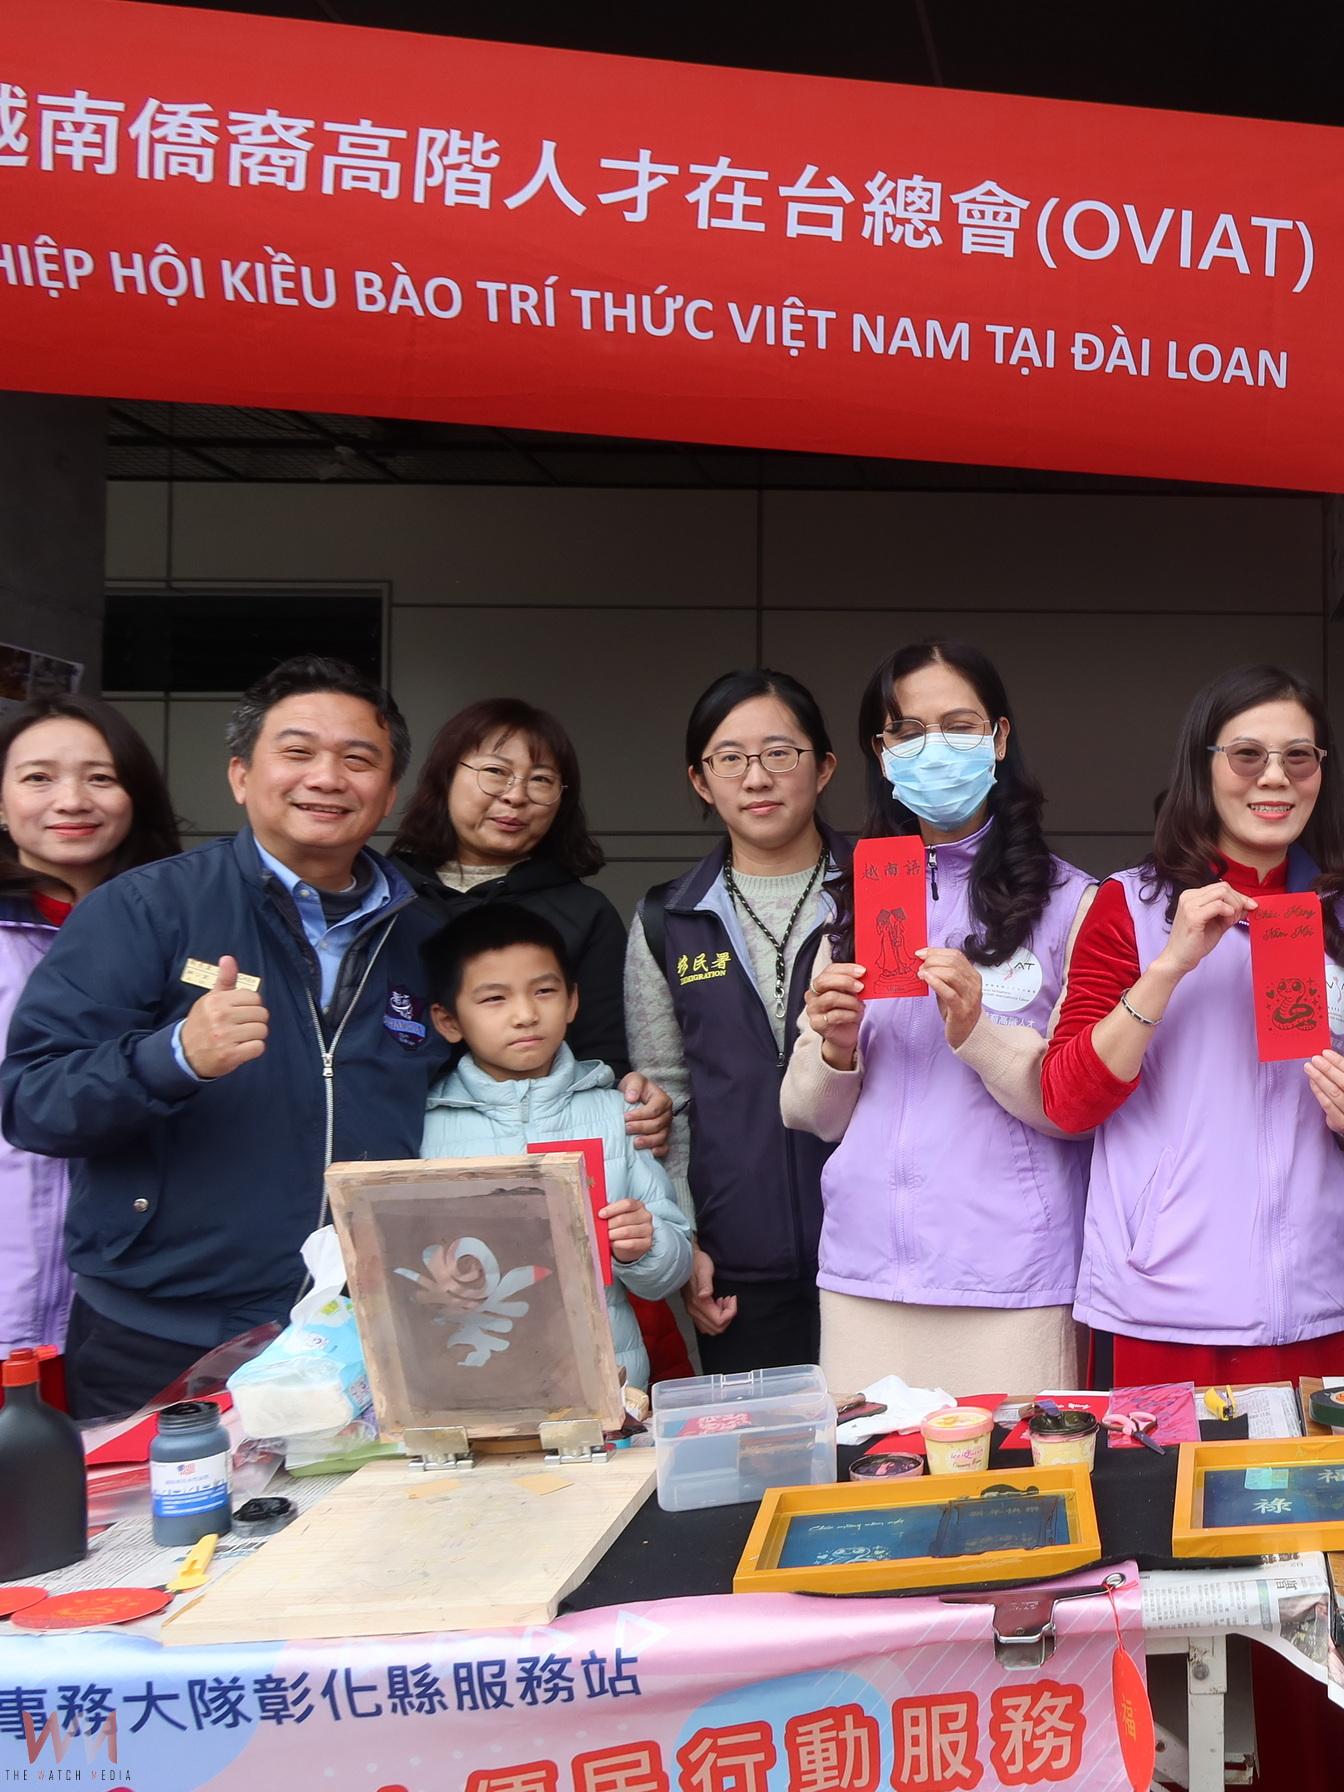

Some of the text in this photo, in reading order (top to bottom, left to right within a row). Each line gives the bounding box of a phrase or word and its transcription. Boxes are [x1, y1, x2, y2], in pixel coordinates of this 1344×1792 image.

[110, 242, 206, 307] HỘI
[222, 245, 338, 310] KIỀU
[355, 262, 463, 320] BÀO
[476, 276, 557, 328] TRÍ
[571, 286, 715, 342] THỨC
[727, 296, 836, 357] VIỆT
[852, 314, 971, 362] NAM
[994, 324, 1056, 376] TẠI
[1071, 324, 1151, 377] ĐÀI
[1167, 340, 1290, 389] LOAN
[677, 952, 731, 977] 移民署
[0, 1647, 643, 1741] 事務大隊彰化縣服務站
[472, 1688, 1076, 1792] 行動服務
